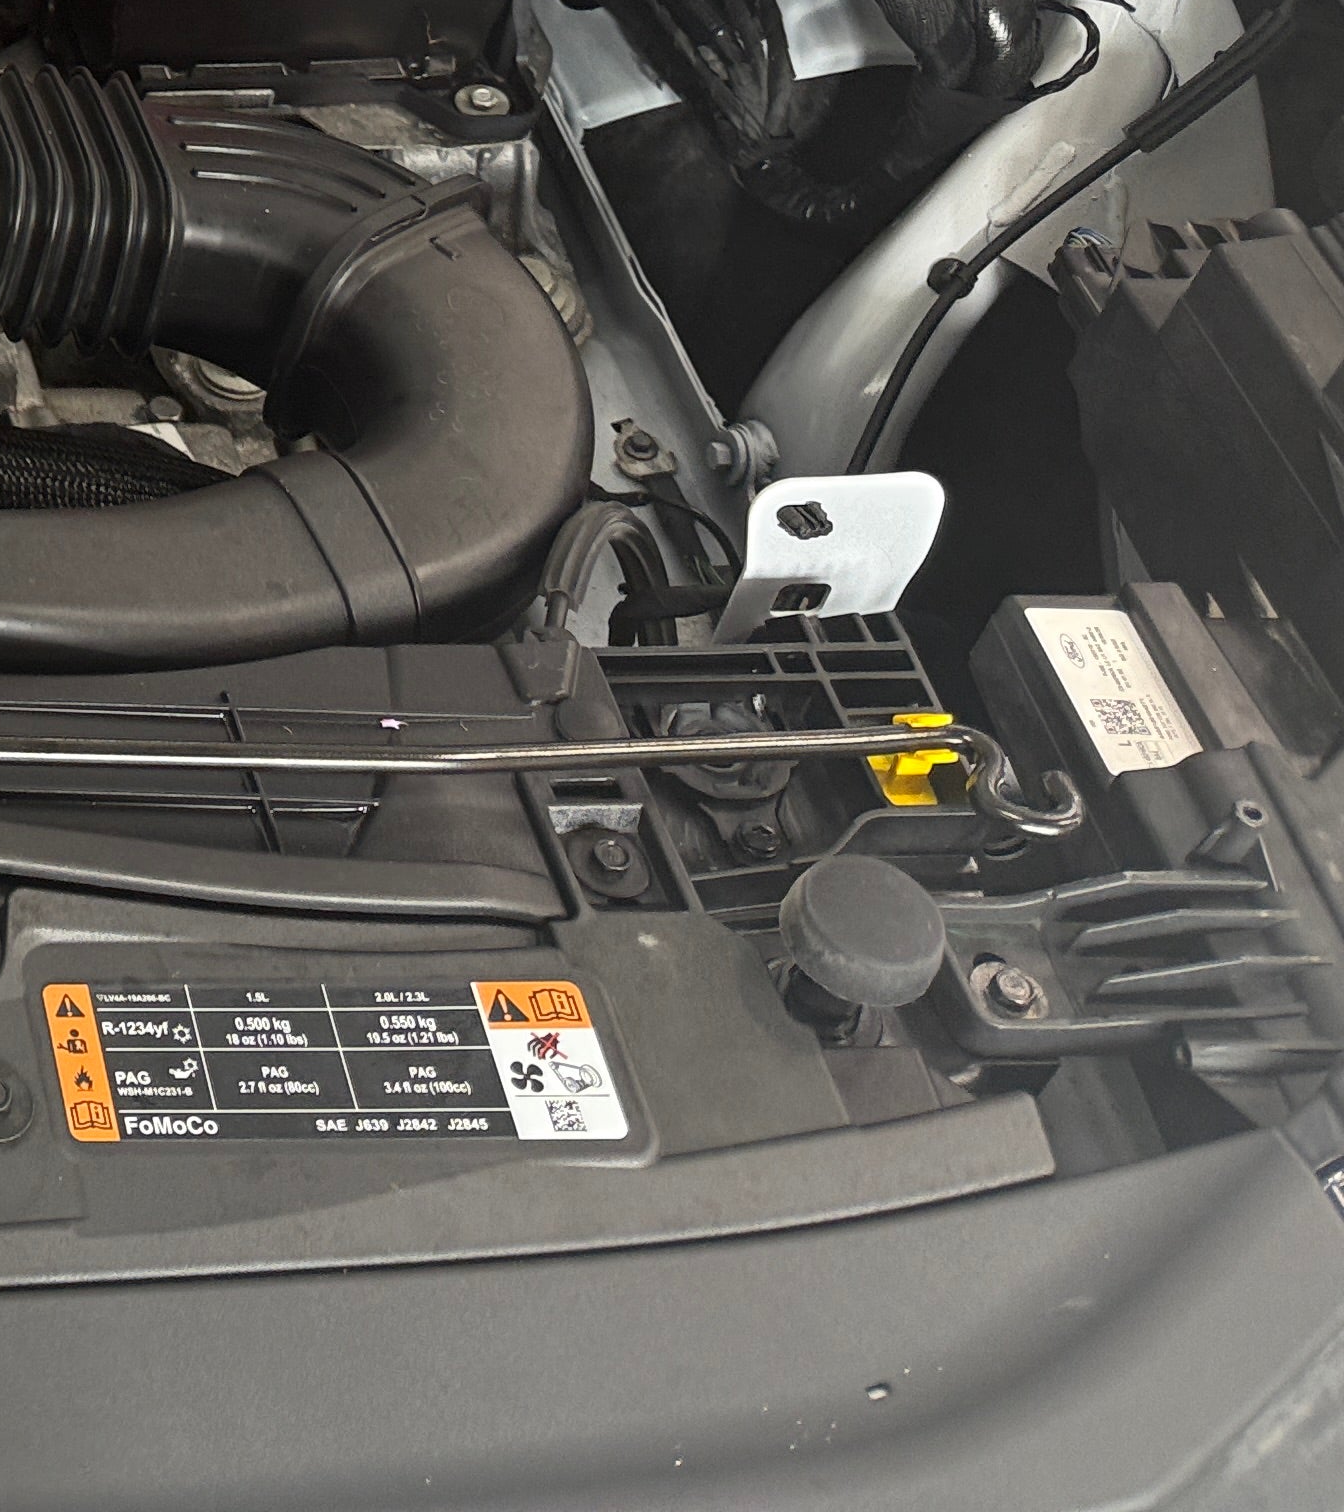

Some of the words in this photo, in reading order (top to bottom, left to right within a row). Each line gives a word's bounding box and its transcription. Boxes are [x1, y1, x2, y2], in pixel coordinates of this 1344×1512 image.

[246, 992, 270, 1002] 1.5L
[374, 992, 399, 1002] 2.0L
[405, 992, 430, 1002] 2.3L
[101, 1020, 169, 1039] R-1234yf
[234, 1017, 270, 1031] 0.500
[272, 1017, 291, 1034] kg
[379, 1016, 416, 1029] 0.550
[417, 1016, 437, 1031] kg
[226, 1034, 240, 1045] 18
[242, 1036, 256, 1045] oz
[257, 1034, 284, 1047] (1.10
[285, 1033, 308, 1047] lbs)
[392, 1034, 407, 1044] oz
[407, 1032, 434, 1045] (1.21
[435, 1031, 459, 1045] lbs)
[114, 1070, 152, 1085] PAG
[261, 1066, 289, 1078] PAG
[408, 1066, 437, 1078] PAG
[238, 1081, 255, 1094] 2.7
[257, 1081, 267, 1093] fl
[268, 1083, 283, 1093] oz
[284, 1081, 320, 1095] (80cc)
[383, 1081, 402, 1094] 3.4
[403, 1081, 412, 1093] fl
[413, 1083, 429, 1093] oz
[429, 1081, 472, 1095] (100cc)
[124, 1116, 219, 1135] FoMoCo
[315, 1119, 348, 1131] SAE
[355, 1118, 389, 1131] J639
[397, 1118, 438, 1131] J2842
[447, 1118, 489, 1131] J2845
